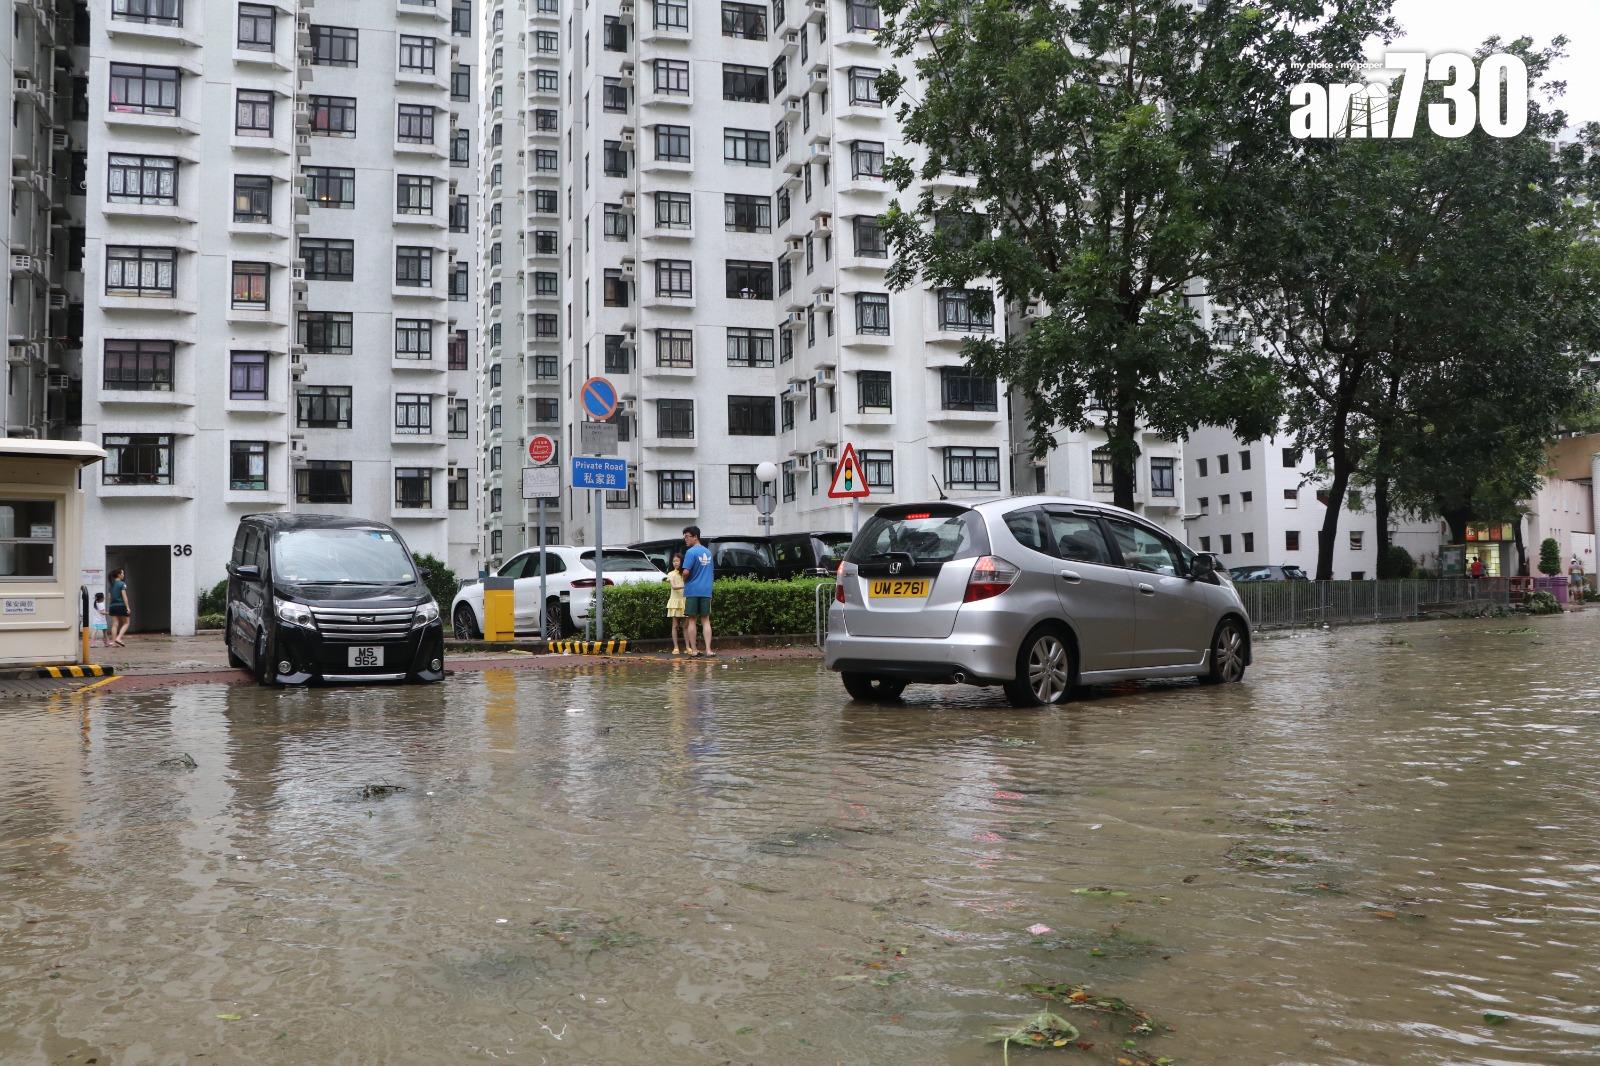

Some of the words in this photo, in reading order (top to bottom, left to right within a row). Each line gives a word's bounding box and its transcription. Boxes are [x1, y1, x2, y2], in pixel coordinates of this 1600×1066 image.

[575, 460, 603, 470] Private
[604, 462, 624, 471] Road
[584, 472, 616, 485] 私家路
[173, 544, 192, 557] 36
[874, 581, 892, 595] UM
[893, 581, 924, 595] 2761
[358, 647, 374, 657] MS
[354, 656, 378, 666] 962
